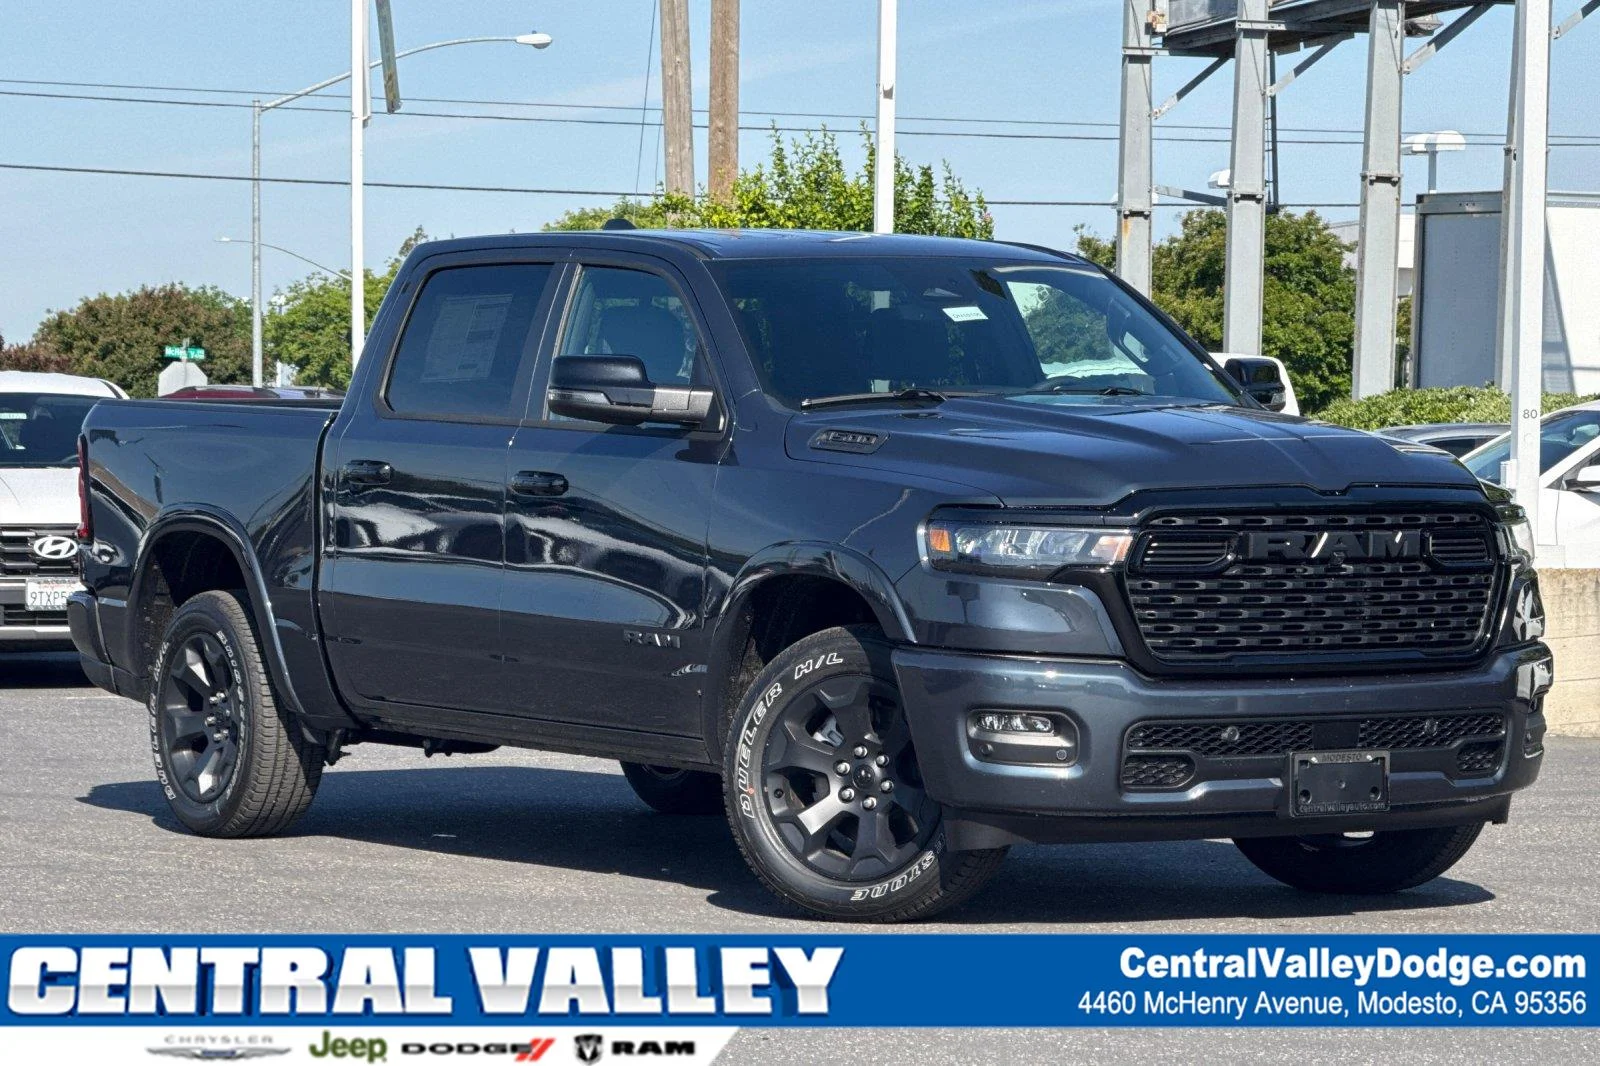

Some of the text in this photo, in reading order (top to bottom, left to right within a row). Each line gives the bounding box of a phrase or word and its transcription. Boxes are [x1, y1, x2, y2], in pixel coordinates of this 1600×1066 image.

[1521, 408, 1538, 420] 80
[1249, 530, 1421, 559] RAM
[623, 629, 681, 649] RAM
[738, 652, 844, 819] DUELER H/L
[1322, 753, 1361, 761] MODESTO
